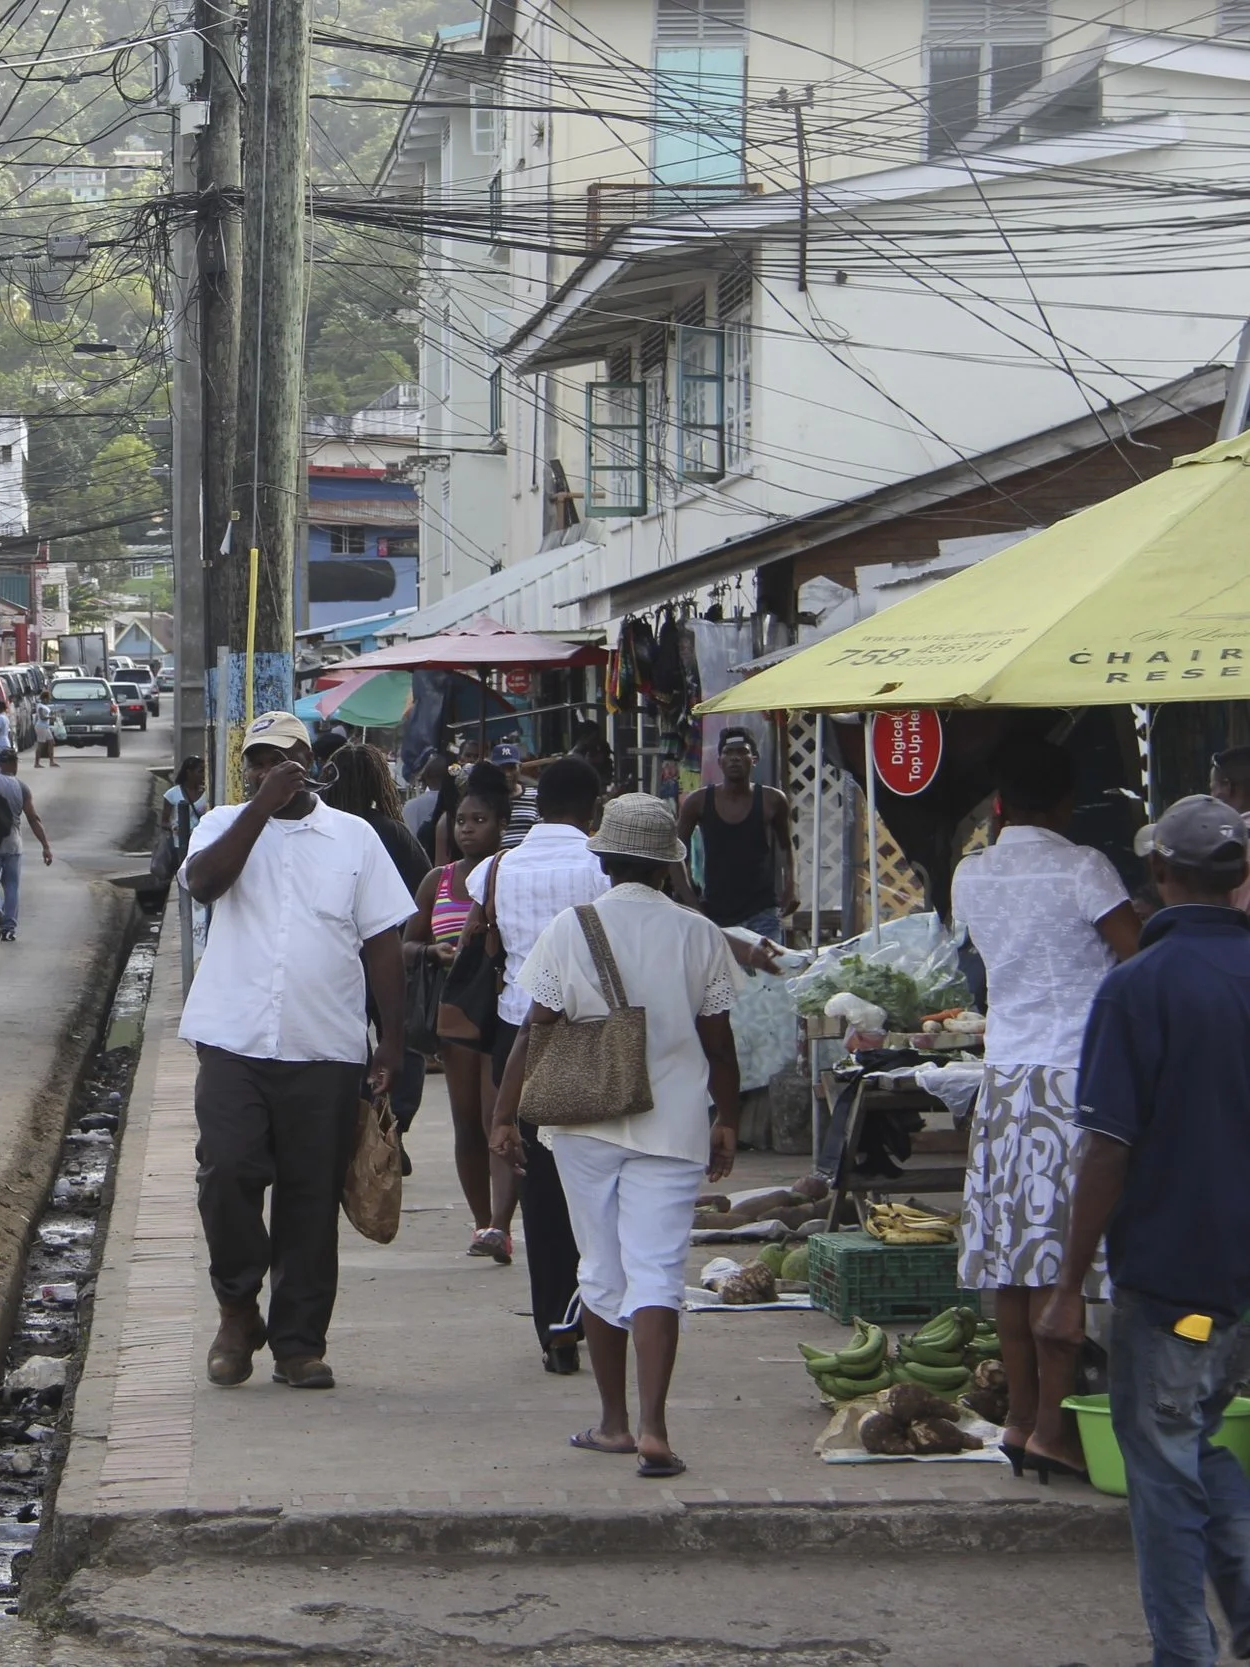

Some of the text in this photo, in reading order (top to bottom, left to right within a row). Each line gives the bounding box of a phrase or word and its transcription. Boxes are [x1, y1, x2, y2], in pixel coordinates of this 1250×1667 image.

[825, 647, 912, 667] 758
[1069, 649, 1244, 664] CHAIR
[1106, 666, 1243, 684] RESE
[891, 717, 906, 764] Digicel
[909, 735, 923, 754] Up
[909, 757, 923, 782] Top
